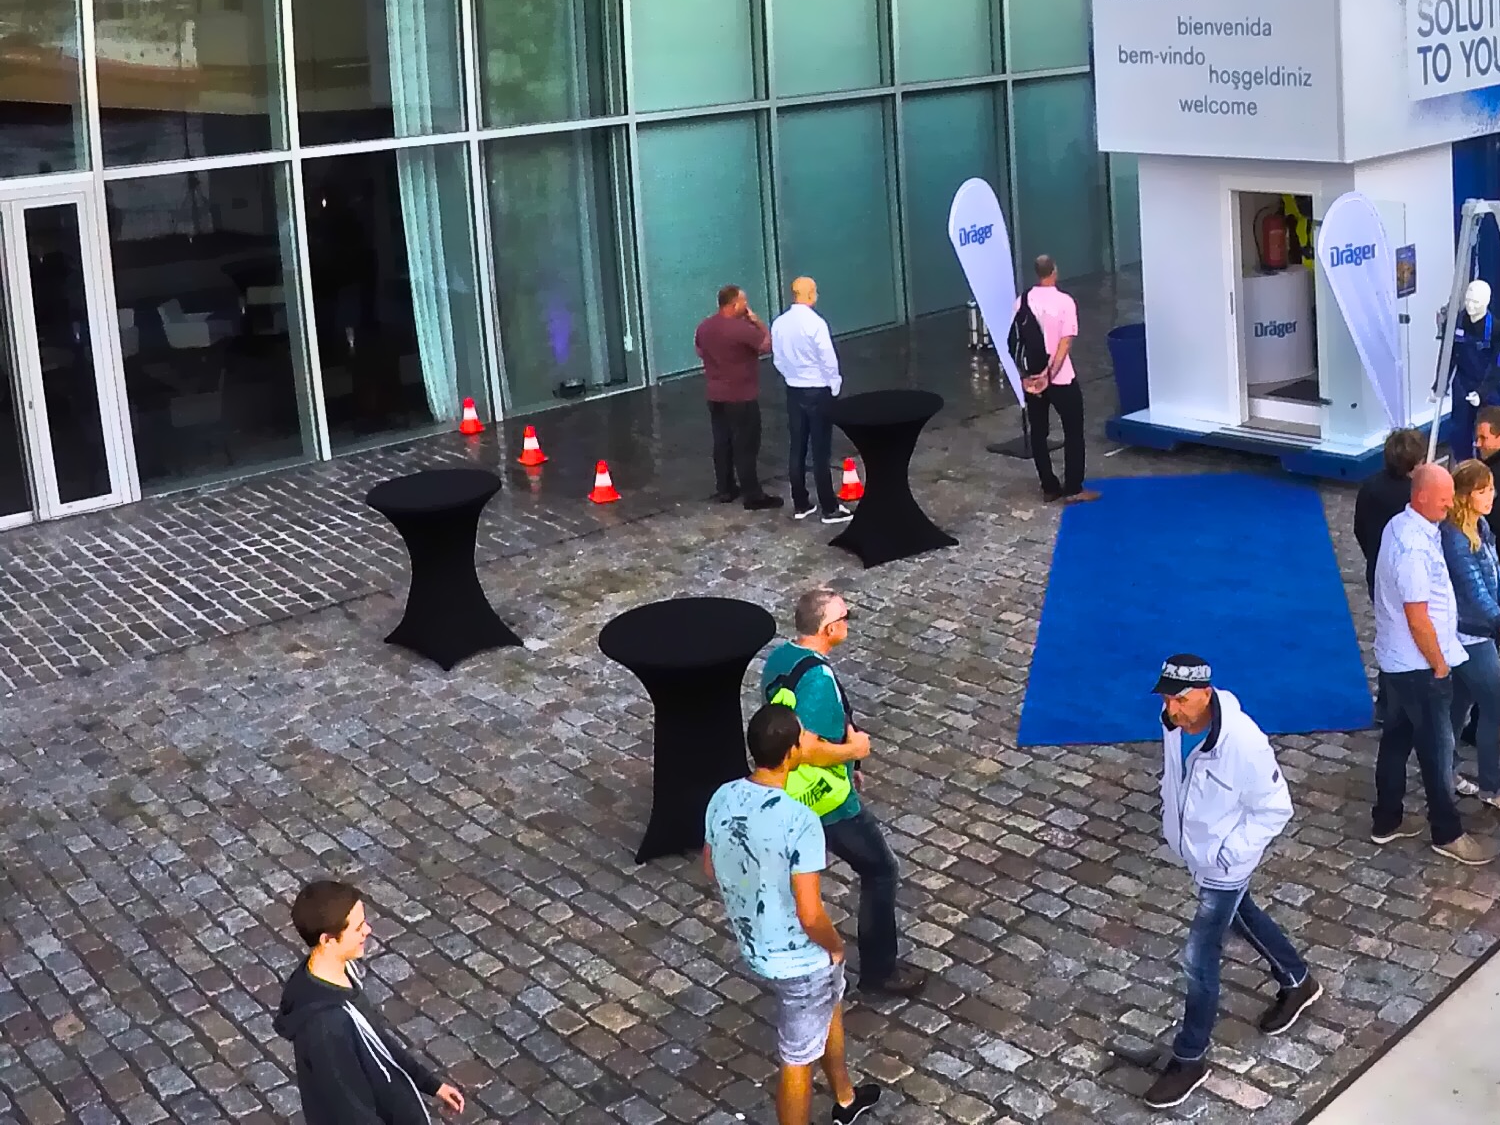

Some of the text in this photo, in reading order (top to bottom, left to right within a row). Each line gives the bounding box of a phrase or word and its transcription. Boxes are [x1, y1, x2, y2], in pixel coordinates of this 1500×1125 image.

[1177, 16, 1272, 36] bienvenida
[1118, 44, 1206, 65] bem-vindo
[1417, 43, 1452, 86] TO
[1208, 64, 1313, 91] hoşgeldiniz
[1178, 95, 1258, 116] welcome
[959, 224, 994, 247] Dräger
[1329, 243, 1377, 268] Dräger
[1254, 320, 1298, 338] Dräger
